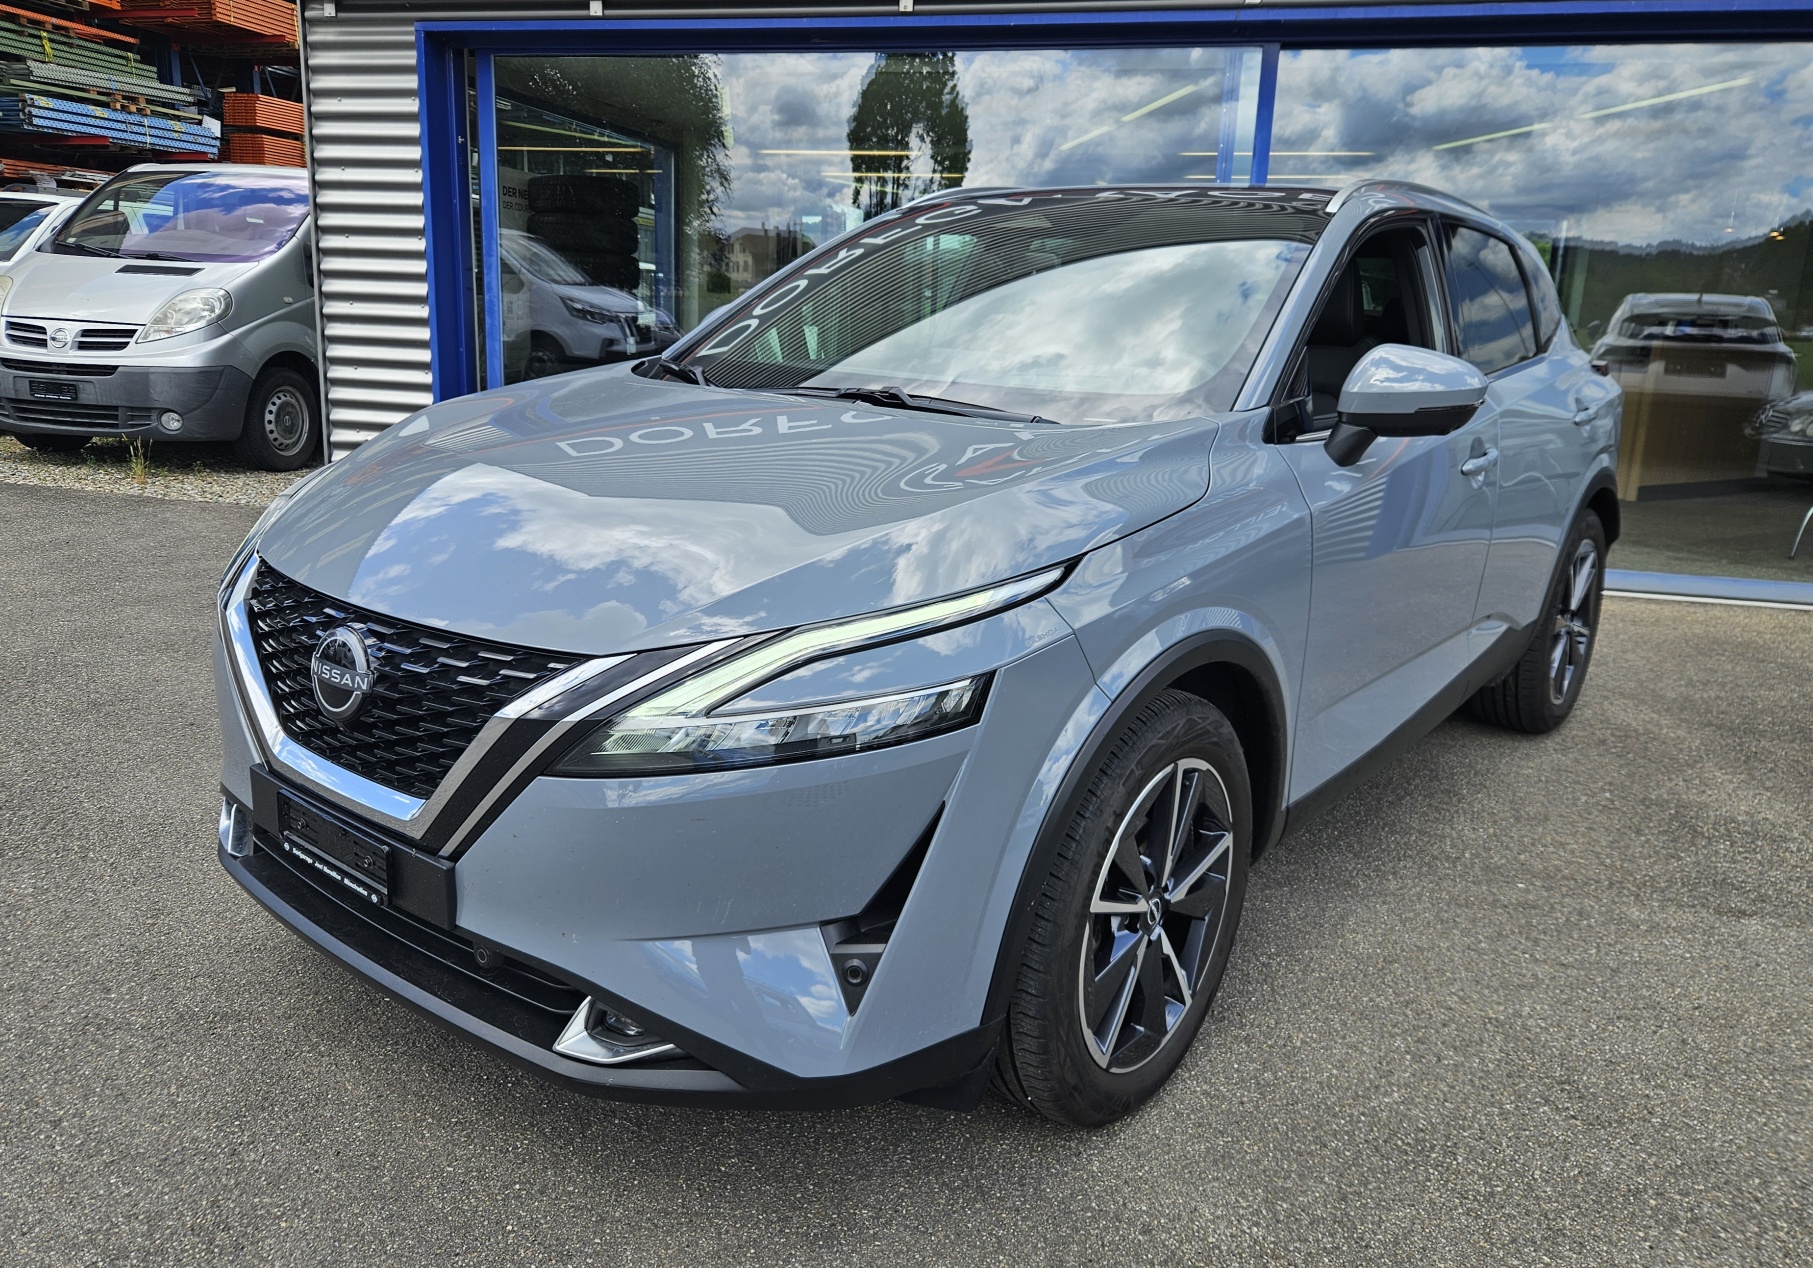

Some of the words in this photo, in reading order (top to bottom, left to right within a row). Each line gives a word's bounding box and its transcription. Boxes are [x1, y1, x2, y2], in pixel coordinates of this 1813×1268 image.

[503, 185, 516, 198] DER
[503, 201, 513, 210] DER
[311, 652, 368, 690] NISSAN
